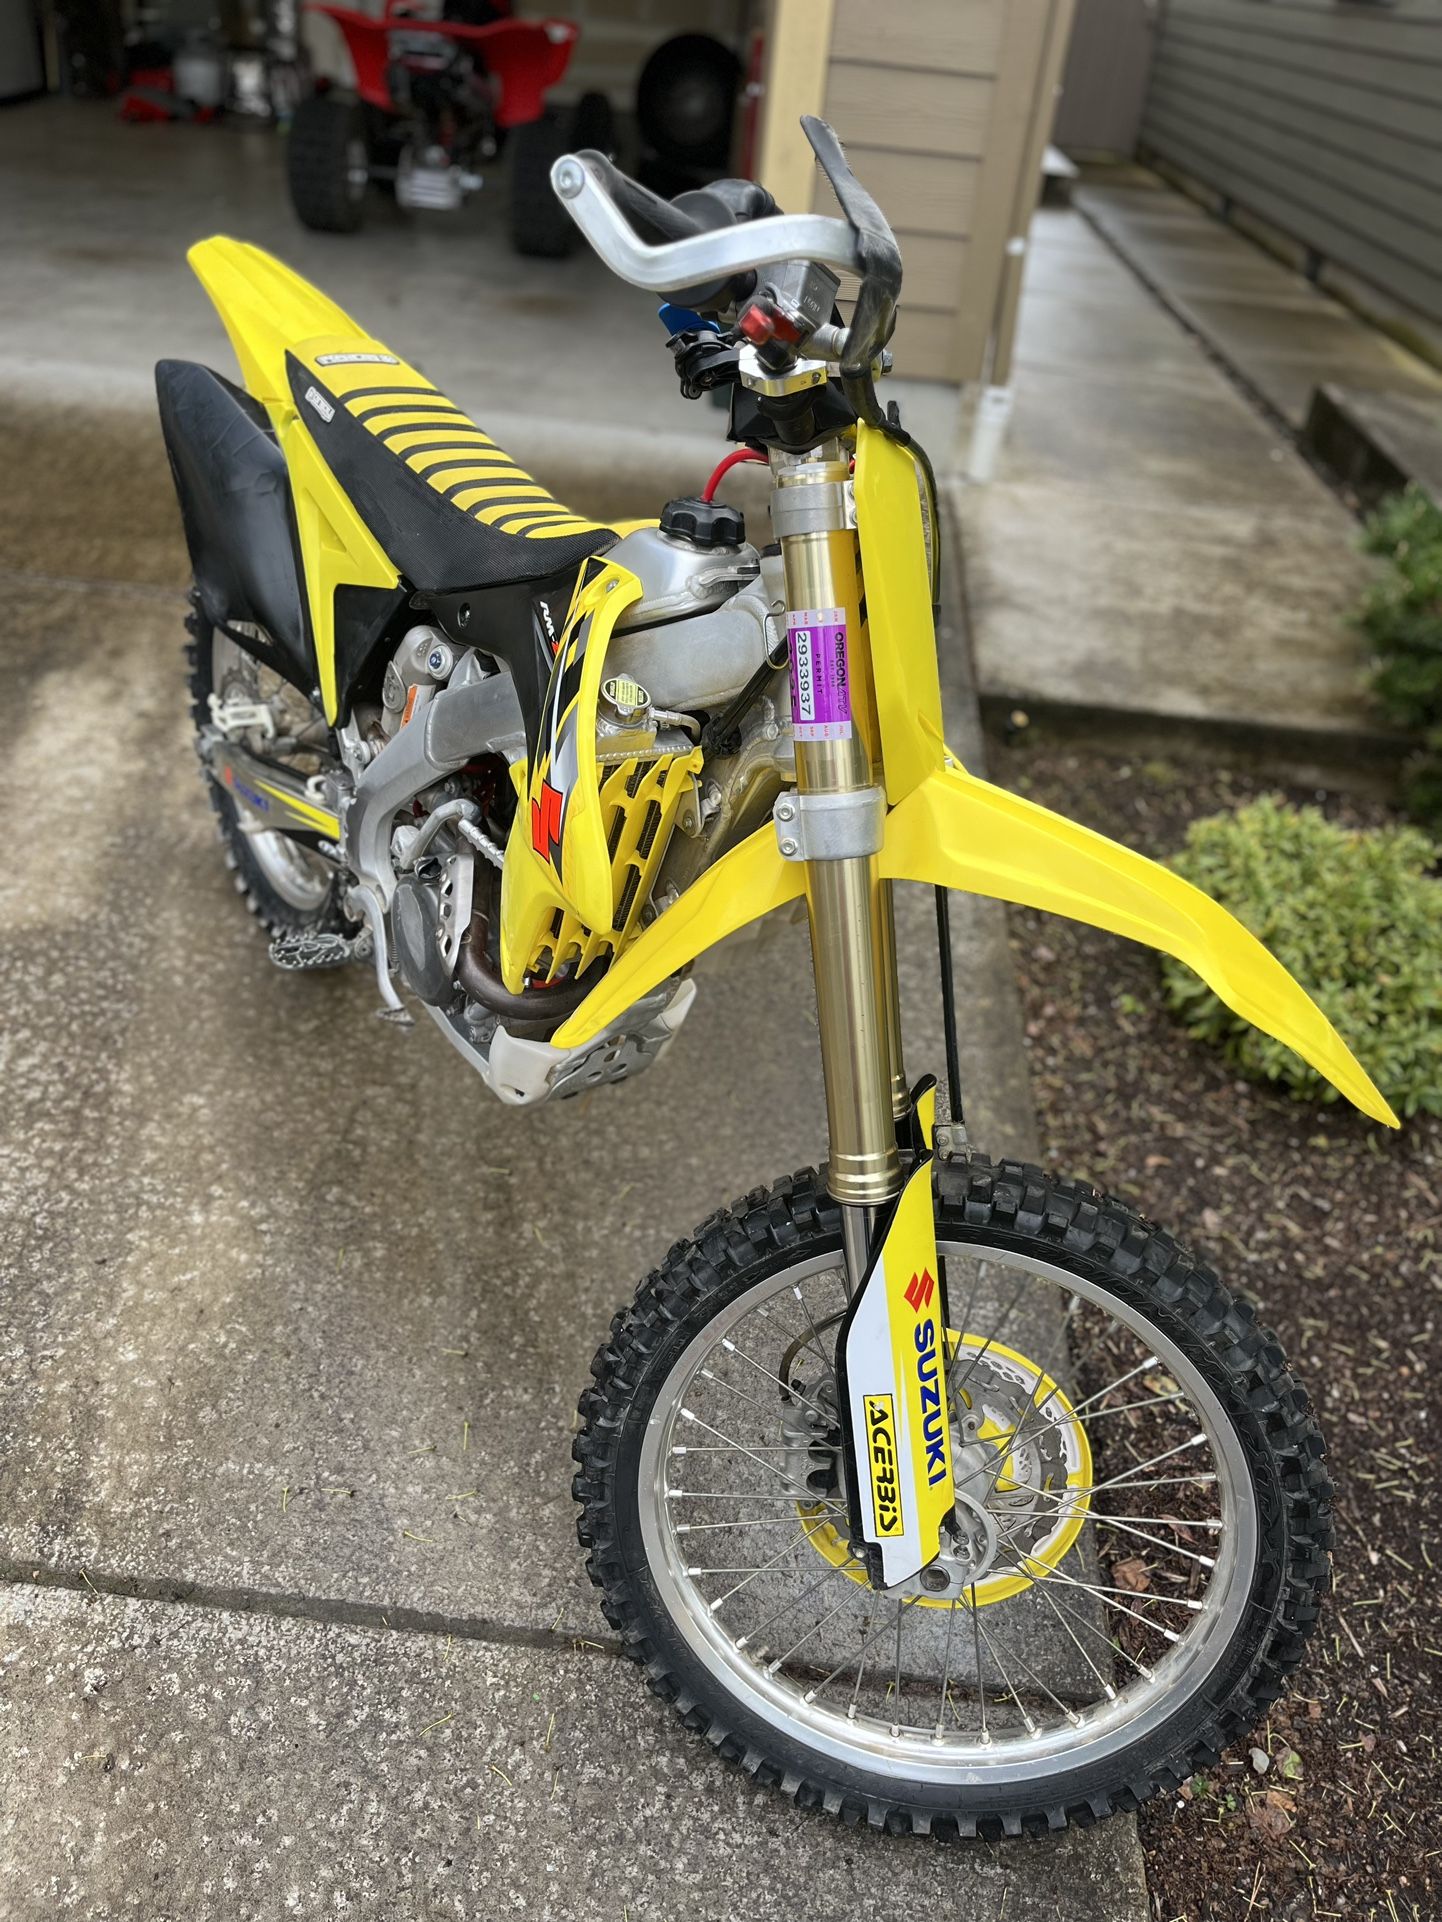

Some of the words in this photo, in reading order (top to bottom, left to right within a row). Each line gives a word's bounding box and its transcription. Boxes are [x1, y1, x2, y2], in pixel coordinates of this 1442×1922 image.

[797, 632, 811, 716] 2933937
[815, 653, 824, 695] PERMIT
[834, 631, 847, 687] OREGON
[234, 777, 270, 813] UKI
[913, 1318, 947, 1487] SUZUKI
